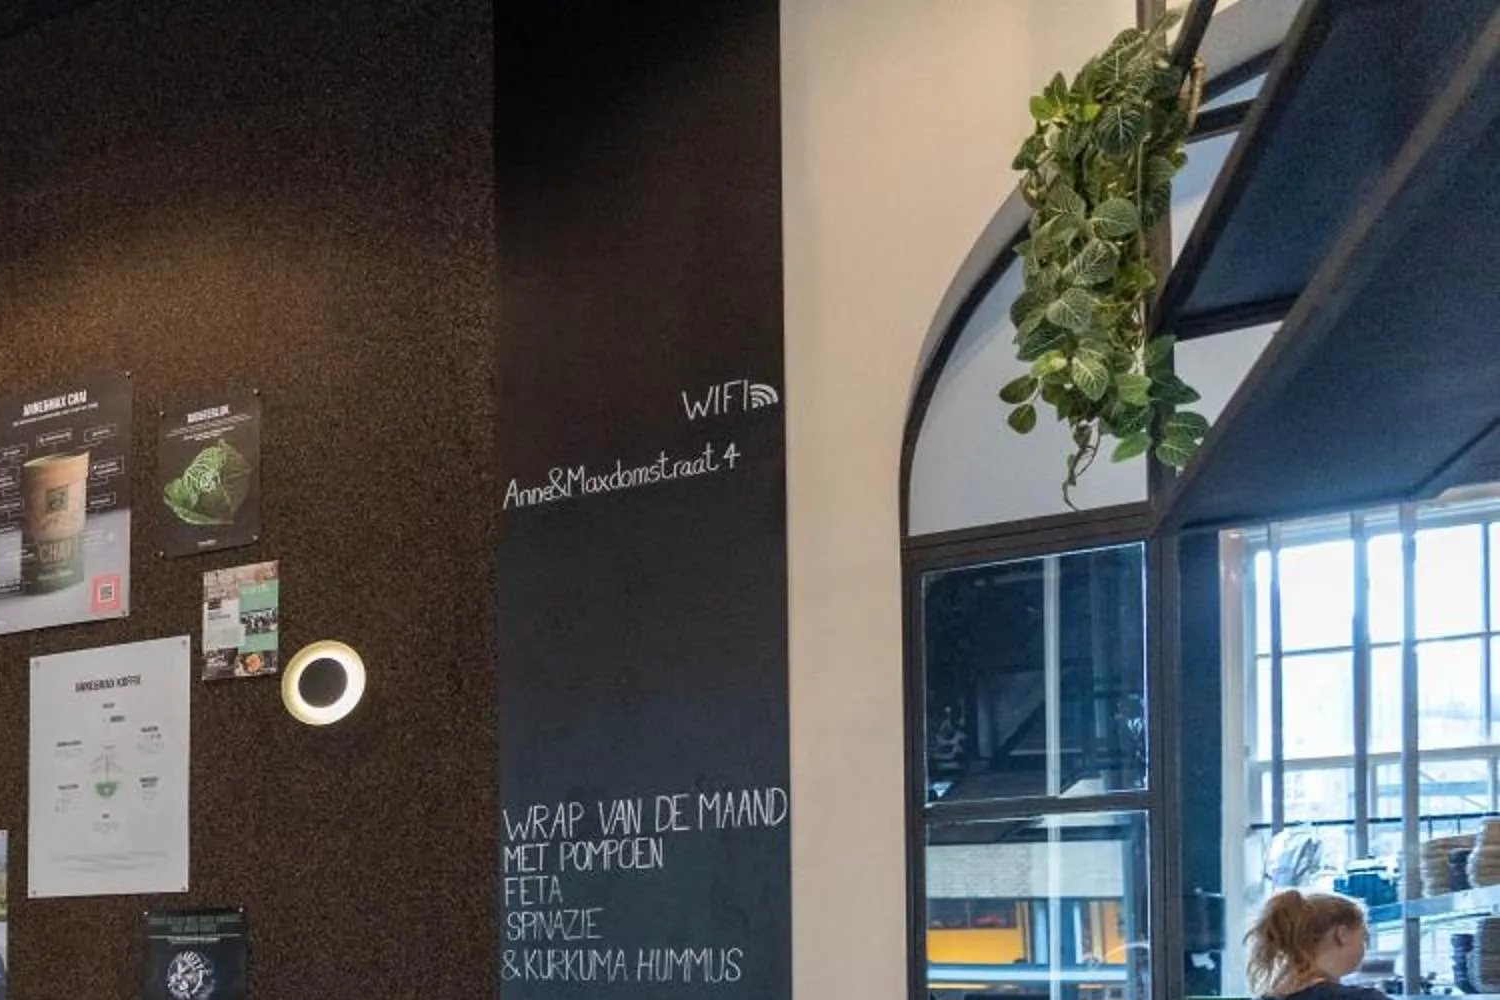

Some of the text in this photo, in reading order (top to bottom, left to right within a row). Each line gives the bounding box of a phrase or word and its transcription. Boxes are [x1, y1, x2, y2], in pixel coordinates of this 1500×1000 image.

[682, 379, 749, 420] WIFI
[503, 787, 788, 841] WRAP VAN DE MAAND
[504, 837, 664, 874] MET POMPOEN
[504, 875, 563, 907] FETA
[507, 907, 605, 941] SPINAZIE
[637, 947, 743, 983] HUMMUS
